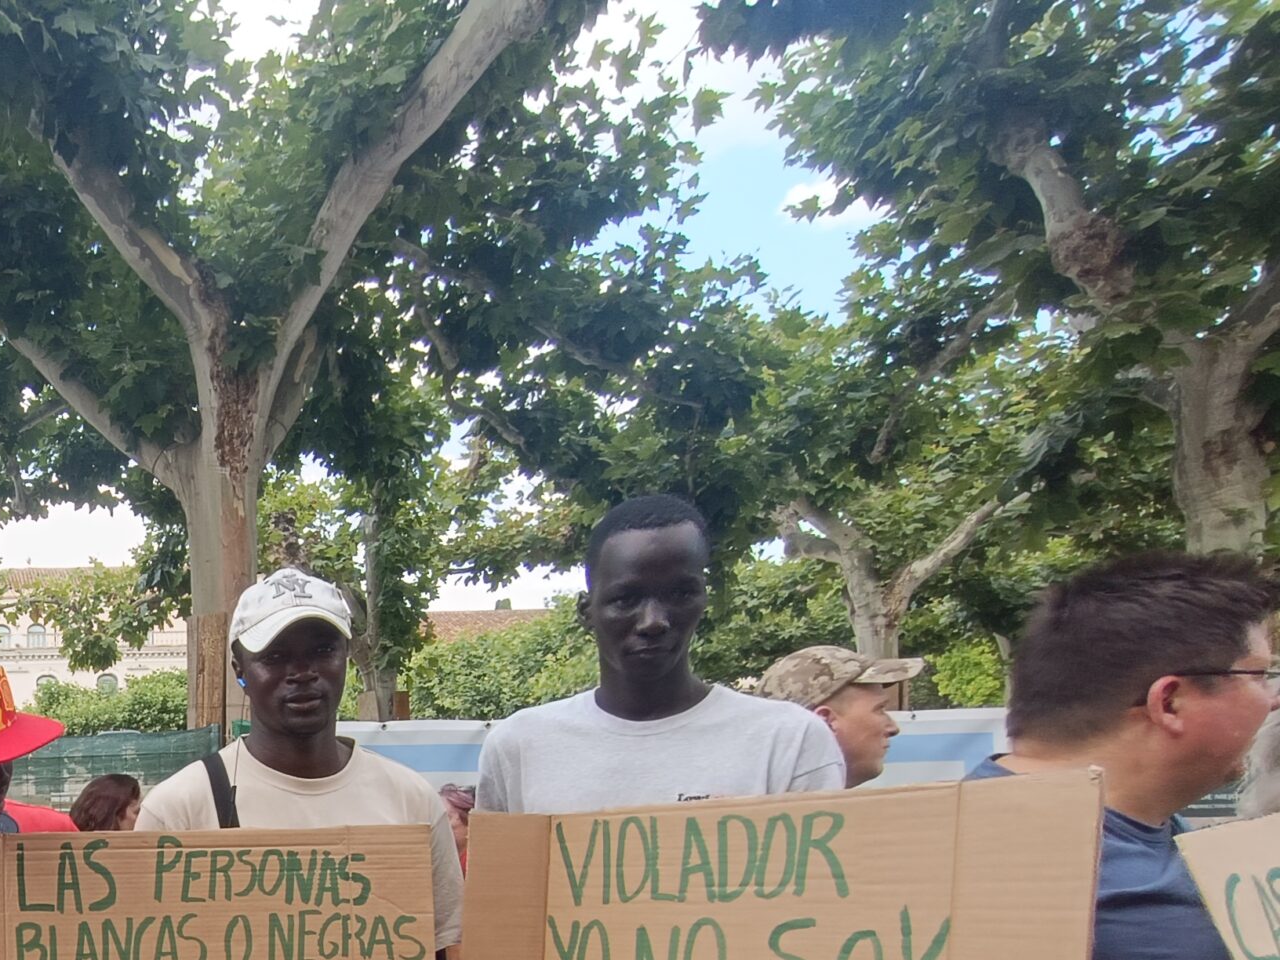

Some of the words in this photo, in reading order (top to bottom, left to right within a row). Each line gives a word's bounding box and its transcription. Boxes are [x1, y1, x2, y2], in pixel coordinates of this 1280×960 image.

[270, 573, 313, 600] NY
[16, 838, 118, 913] LAS
[154, 835, 372, 907] PERSONAS
[556, 810, 849, 906] VIOLADOR
